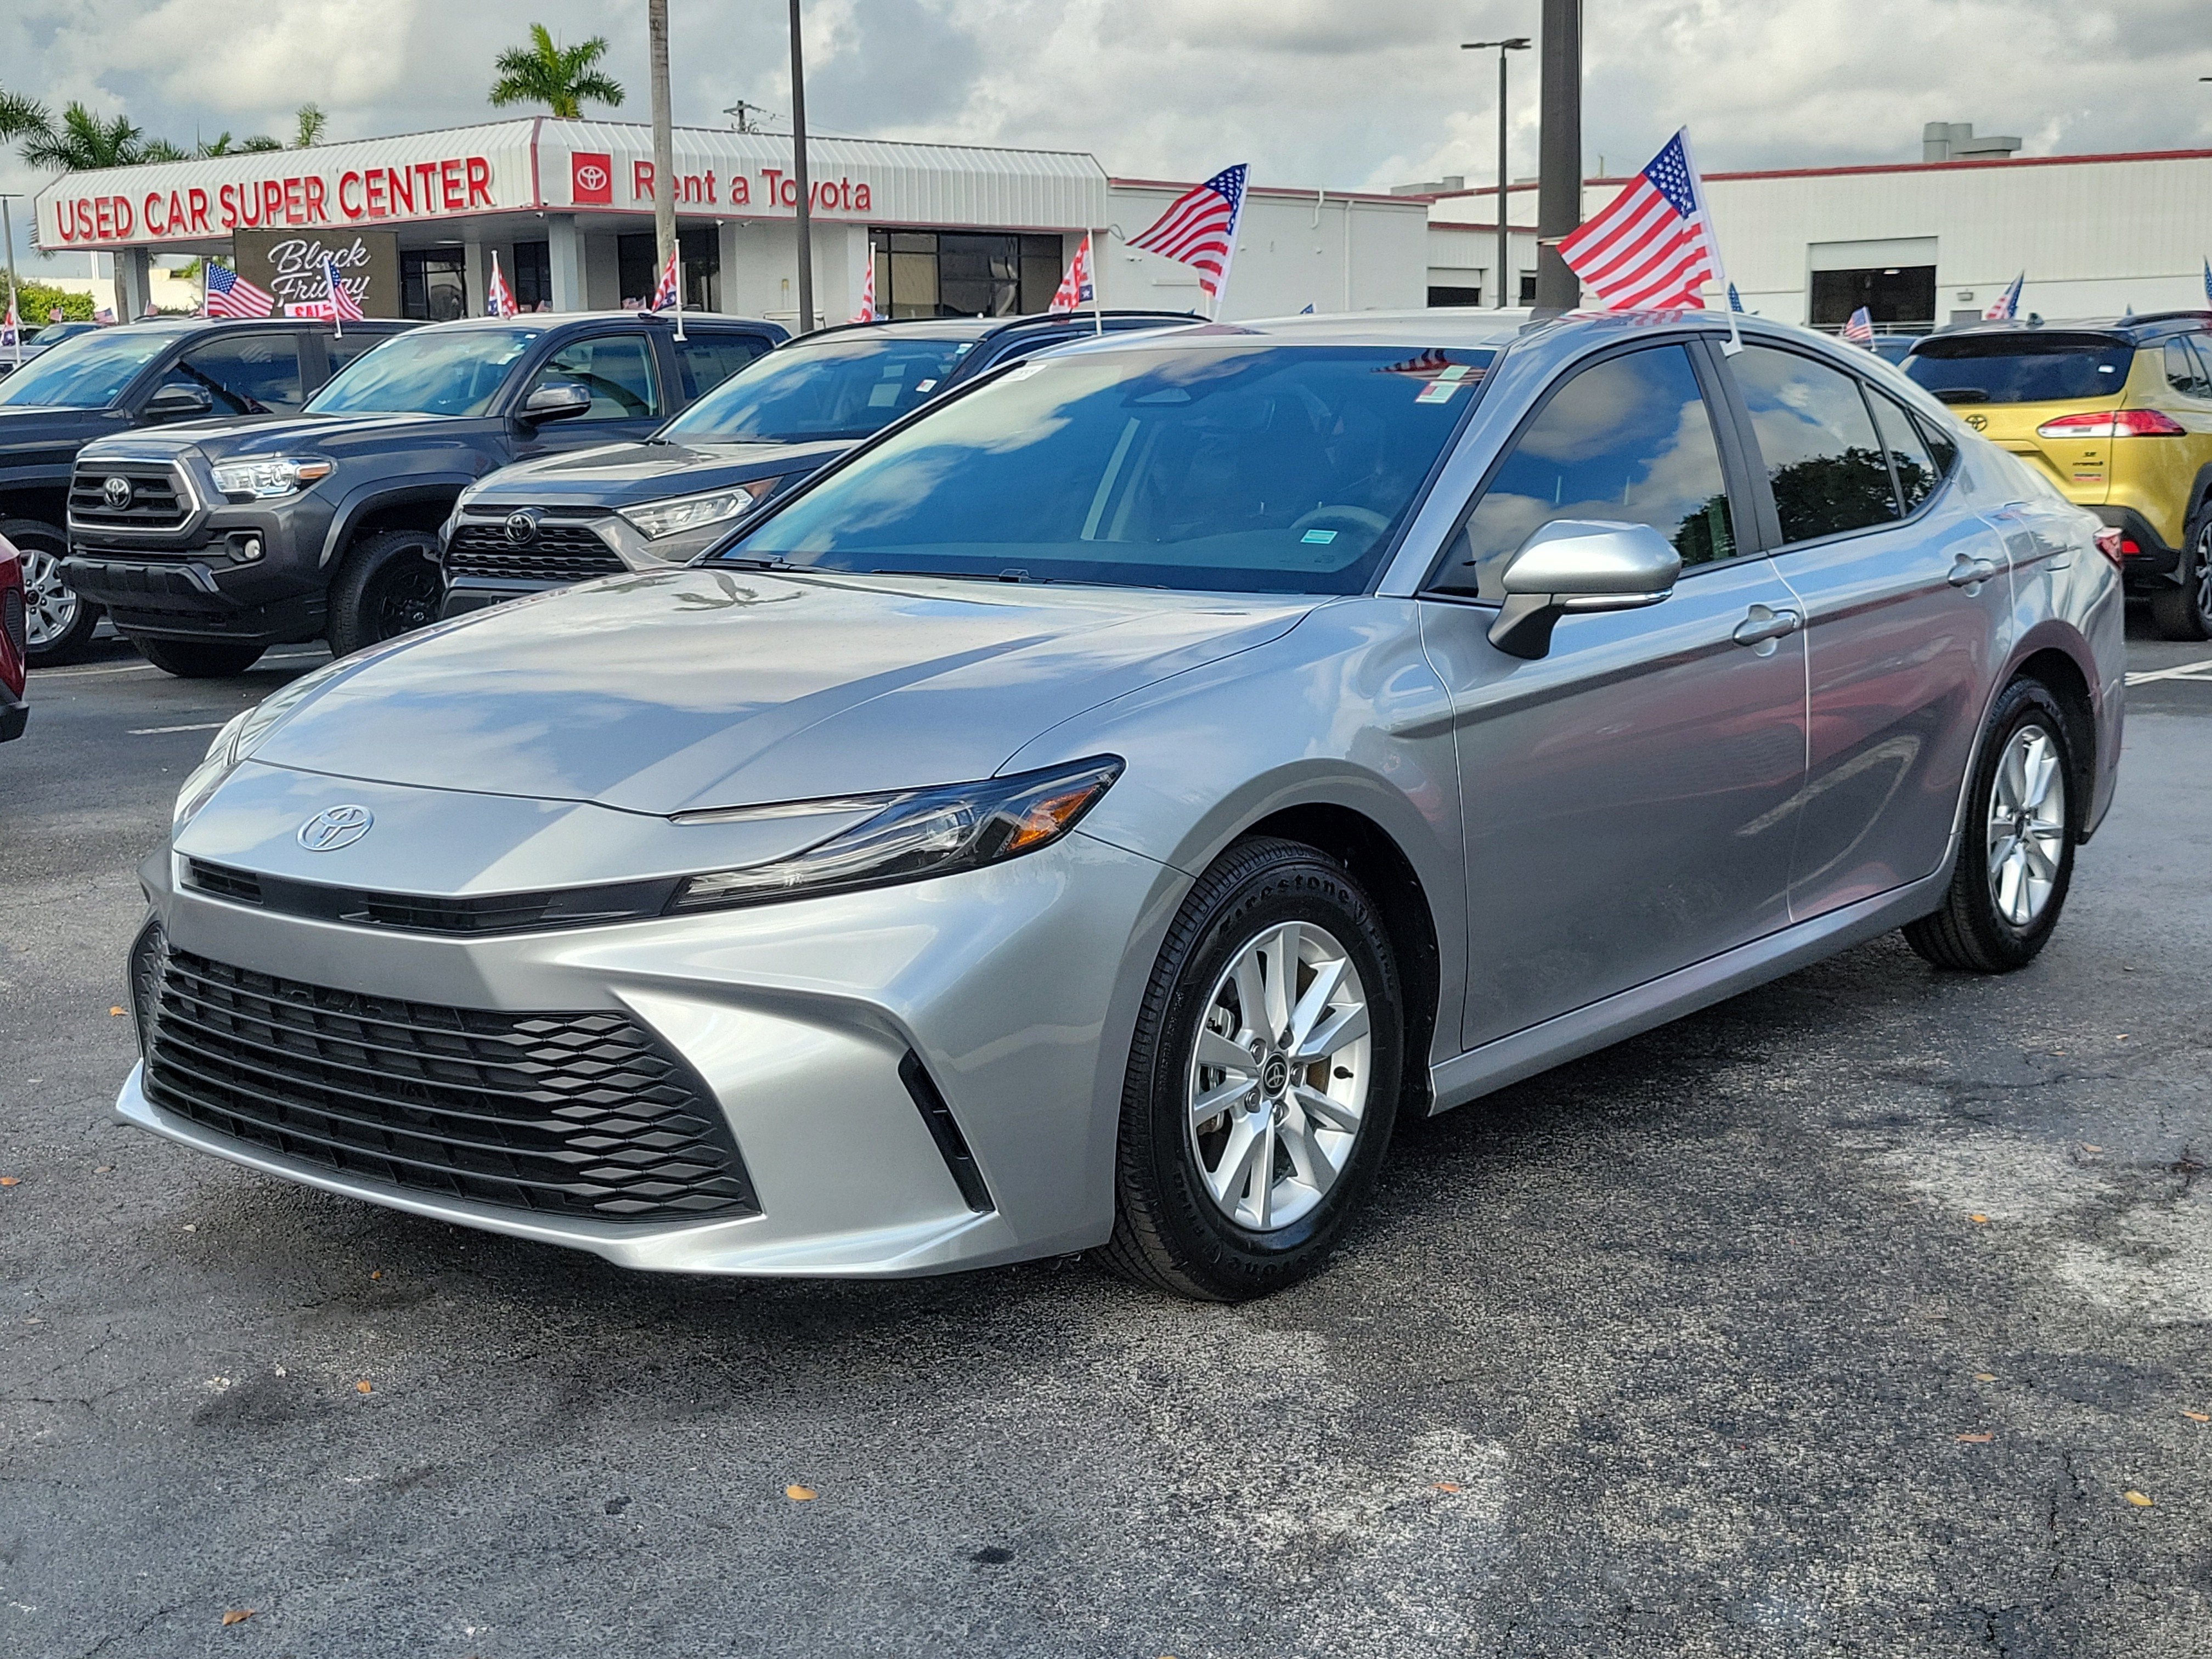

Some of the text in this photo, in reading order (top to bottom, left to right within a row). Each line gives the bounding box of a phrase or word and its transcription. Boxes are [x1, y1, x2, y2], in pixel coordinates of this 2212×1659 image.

[57, 157, 492, 241] USED CAR SUPER CENTER
[731, 176, 751, 205] a
[267, 236, 371, 273] Black
